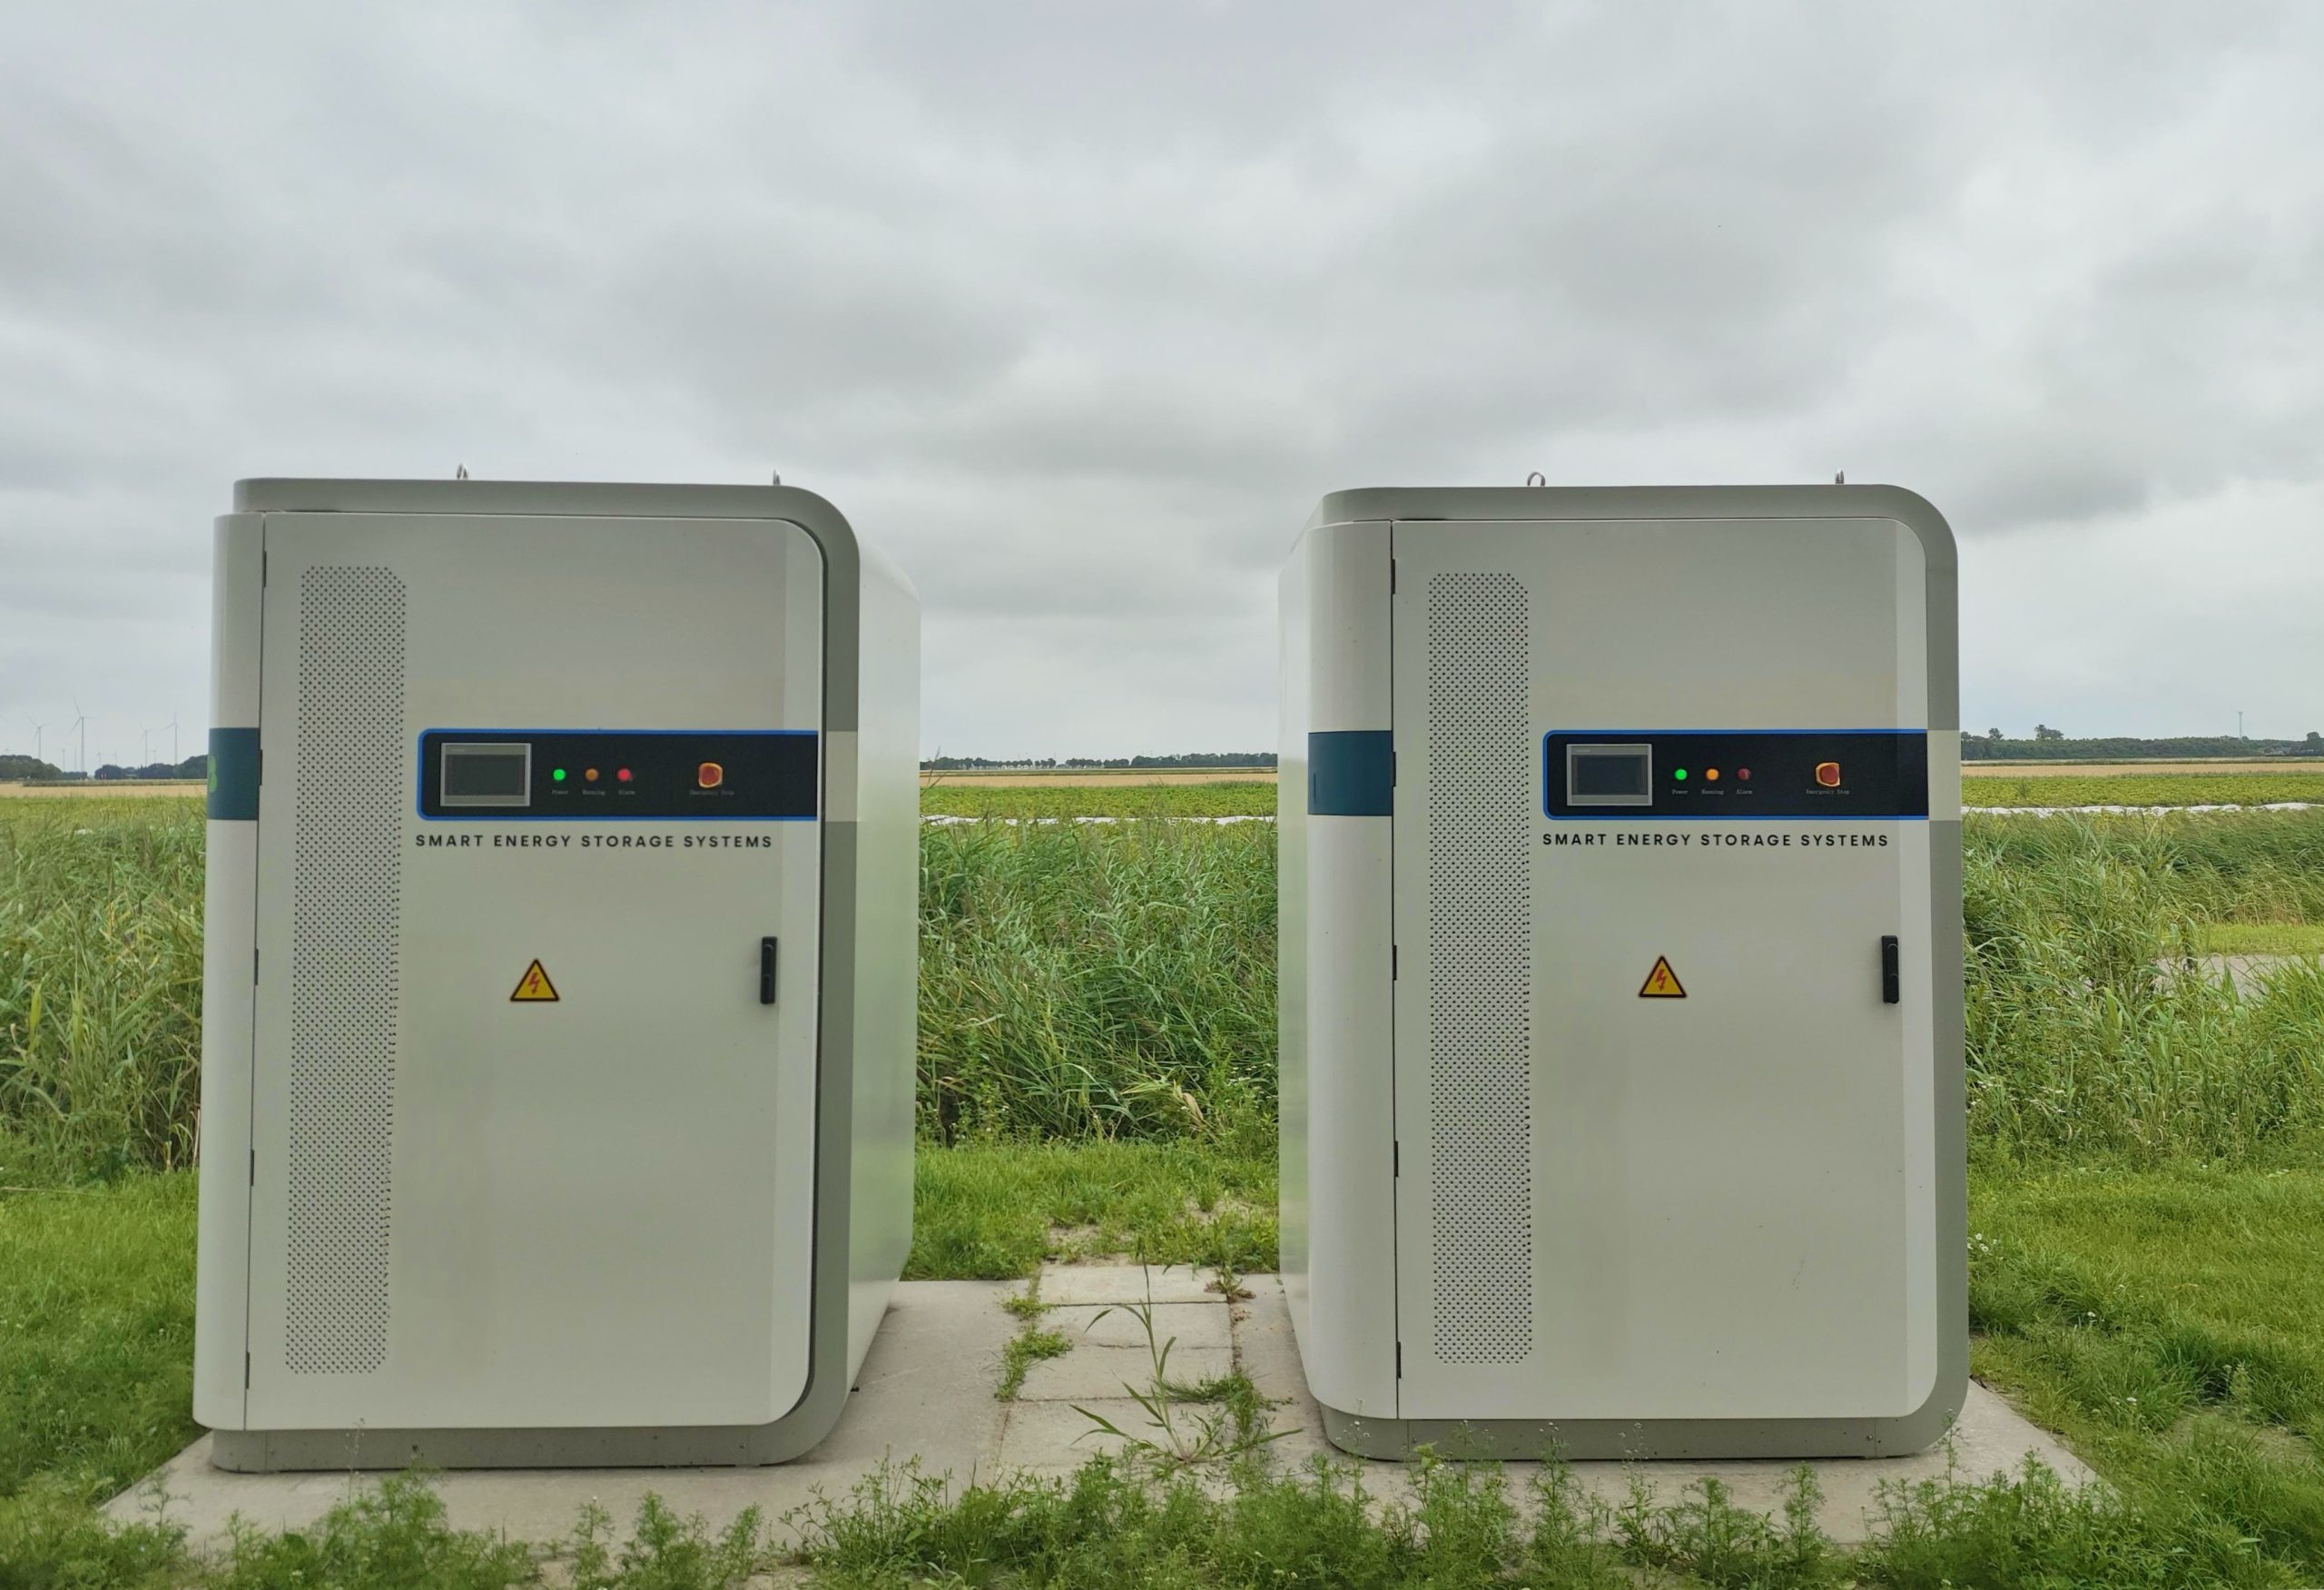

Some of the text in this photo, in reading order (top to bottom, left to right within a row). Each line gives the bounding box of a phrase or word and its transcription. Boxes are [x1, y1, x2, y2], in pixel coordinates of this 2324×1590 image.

[415, 834, 772, 849] SMART ENERGY STORAGE SYSTEMS
[1542, 833, 1888, 847] SMART ENERGY STORAGE SYSTEMS
